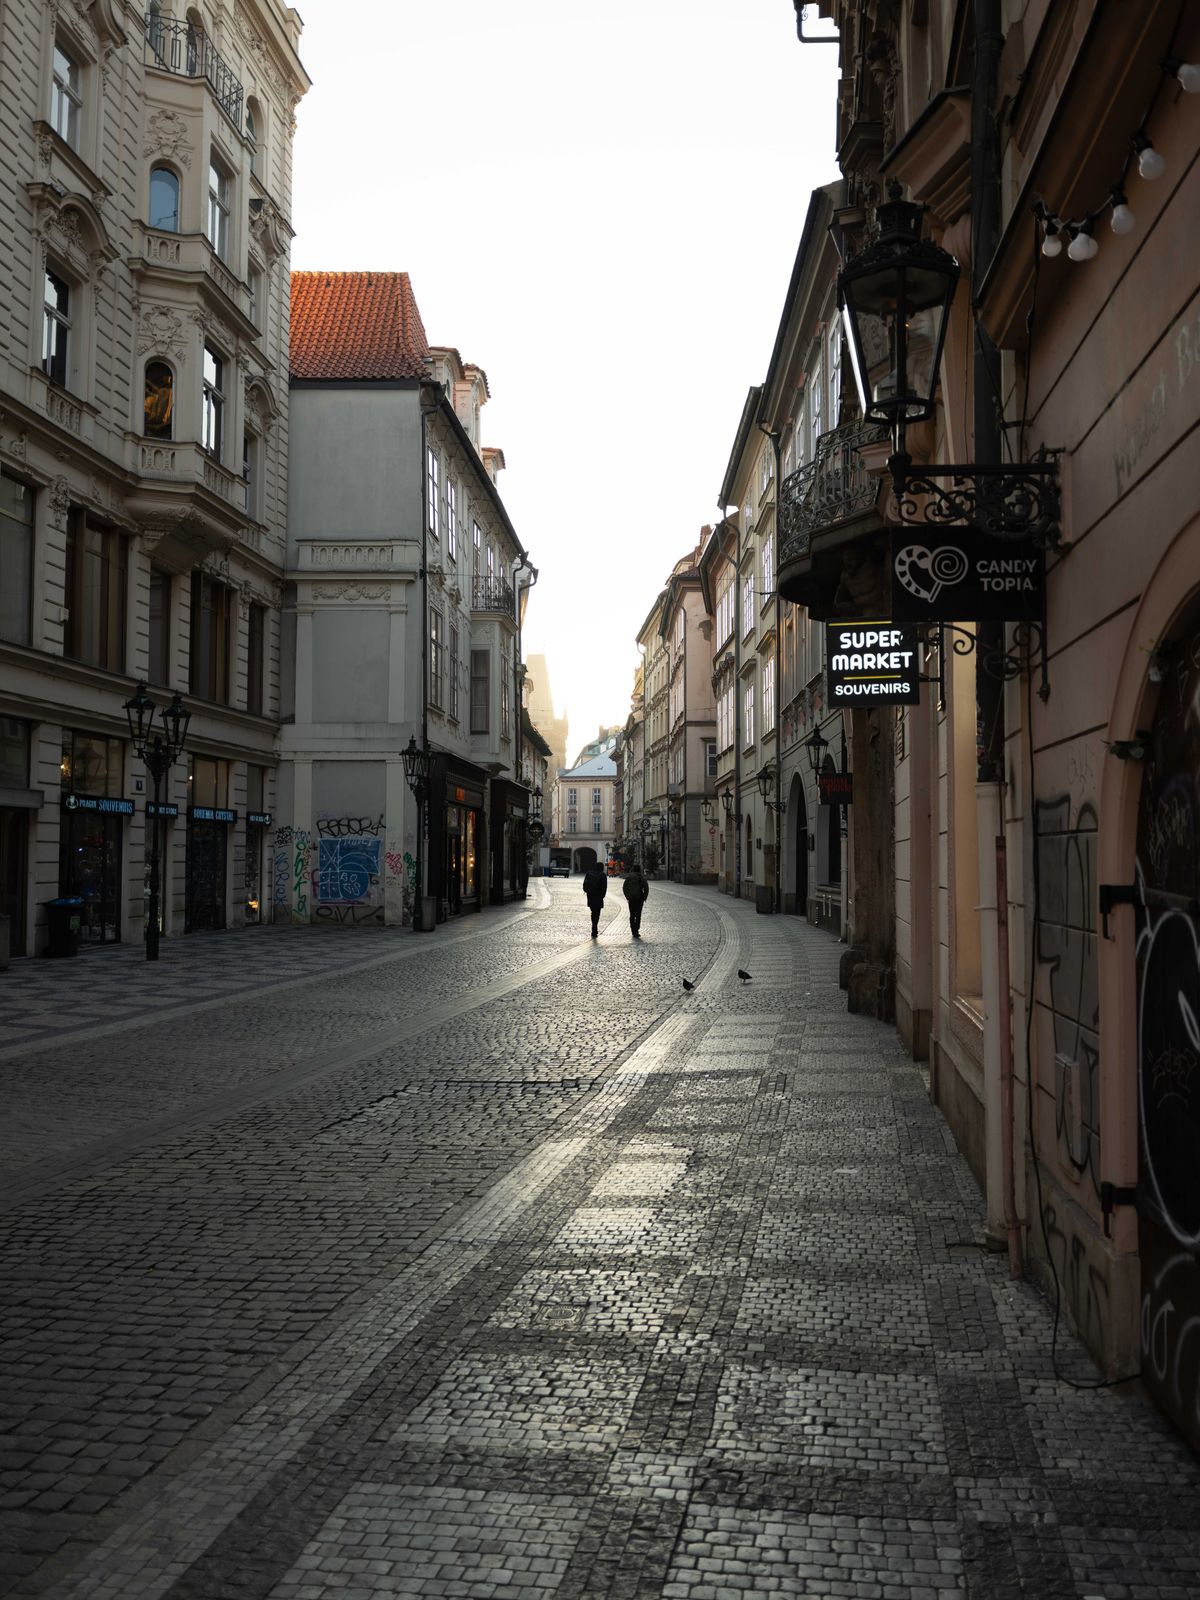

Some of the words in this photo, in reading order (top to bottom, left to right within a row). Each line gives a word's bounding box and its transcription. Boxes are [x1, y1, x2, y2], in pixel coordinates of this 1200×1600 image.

[975, 559, 1037, 574] CANDY
[979, 577, 1035, 592] TOPIA
[839, 630, 904, 649] SUPER
[832, 651, 914, 671] MARKET
[834, 682, 911, 696] SOUVENIRS
[98, 799, 133, 814] SOUVENIRS
[193, 808, 214, 820] BOHEMIA
[215, 810, 234, 821] CRYSTAL
